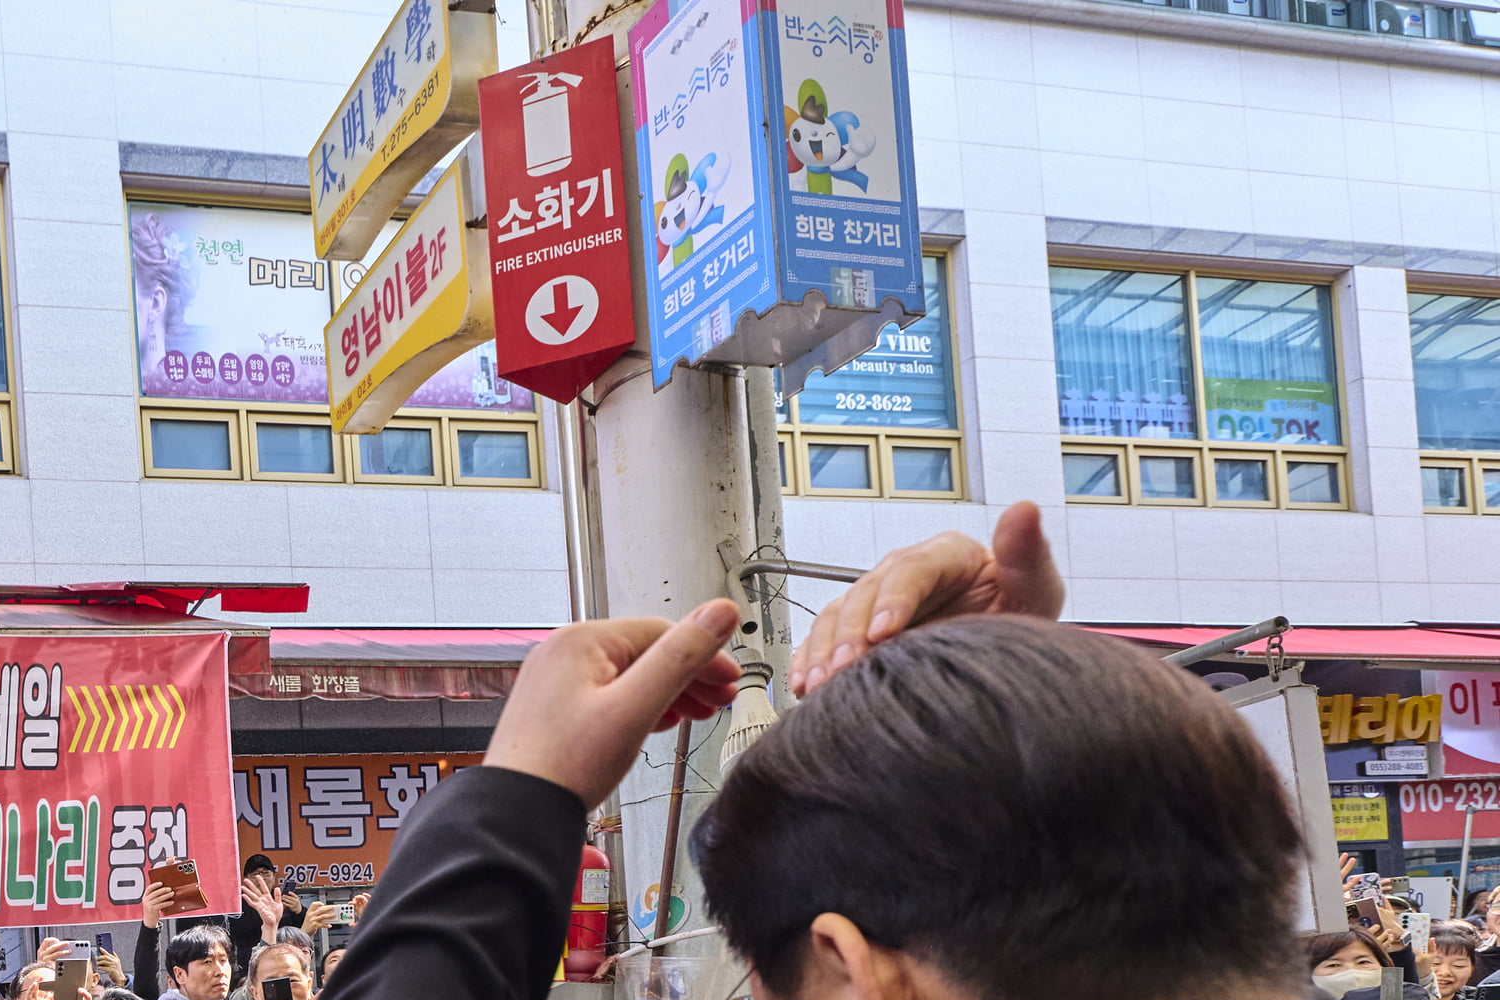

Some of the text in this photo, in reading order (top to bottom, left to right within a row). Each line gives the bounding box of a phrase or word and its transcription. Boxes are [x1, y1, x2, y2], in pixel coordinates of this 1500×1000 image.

[784, 14, 879, 64] 반송시장
[654, 52, 734, 136] 반송시장
[380, 70, 440, 163] T.275-6381
[496, 168, 614, 243] 소화기
[795, 213, 901, 248] 희망 찬거리
[196, 235, 244, 266] 천연
[495, 227, 623, 275] FIRE EXTINGUISHER
[248, 256, 325, 291] 머리
[663, 229, 755, 320] 희망 찬거리
[341, 225, 447, 377] 영남이불 2F
[886, 330, 932, 353] vine
[853, 360, 933, 375] beauty salon
[835, 392, 912, 412] 262-8622
[269, 674, 360, 694] 새롬 화장품
[1400, 782, 1500, 813] 010-232
